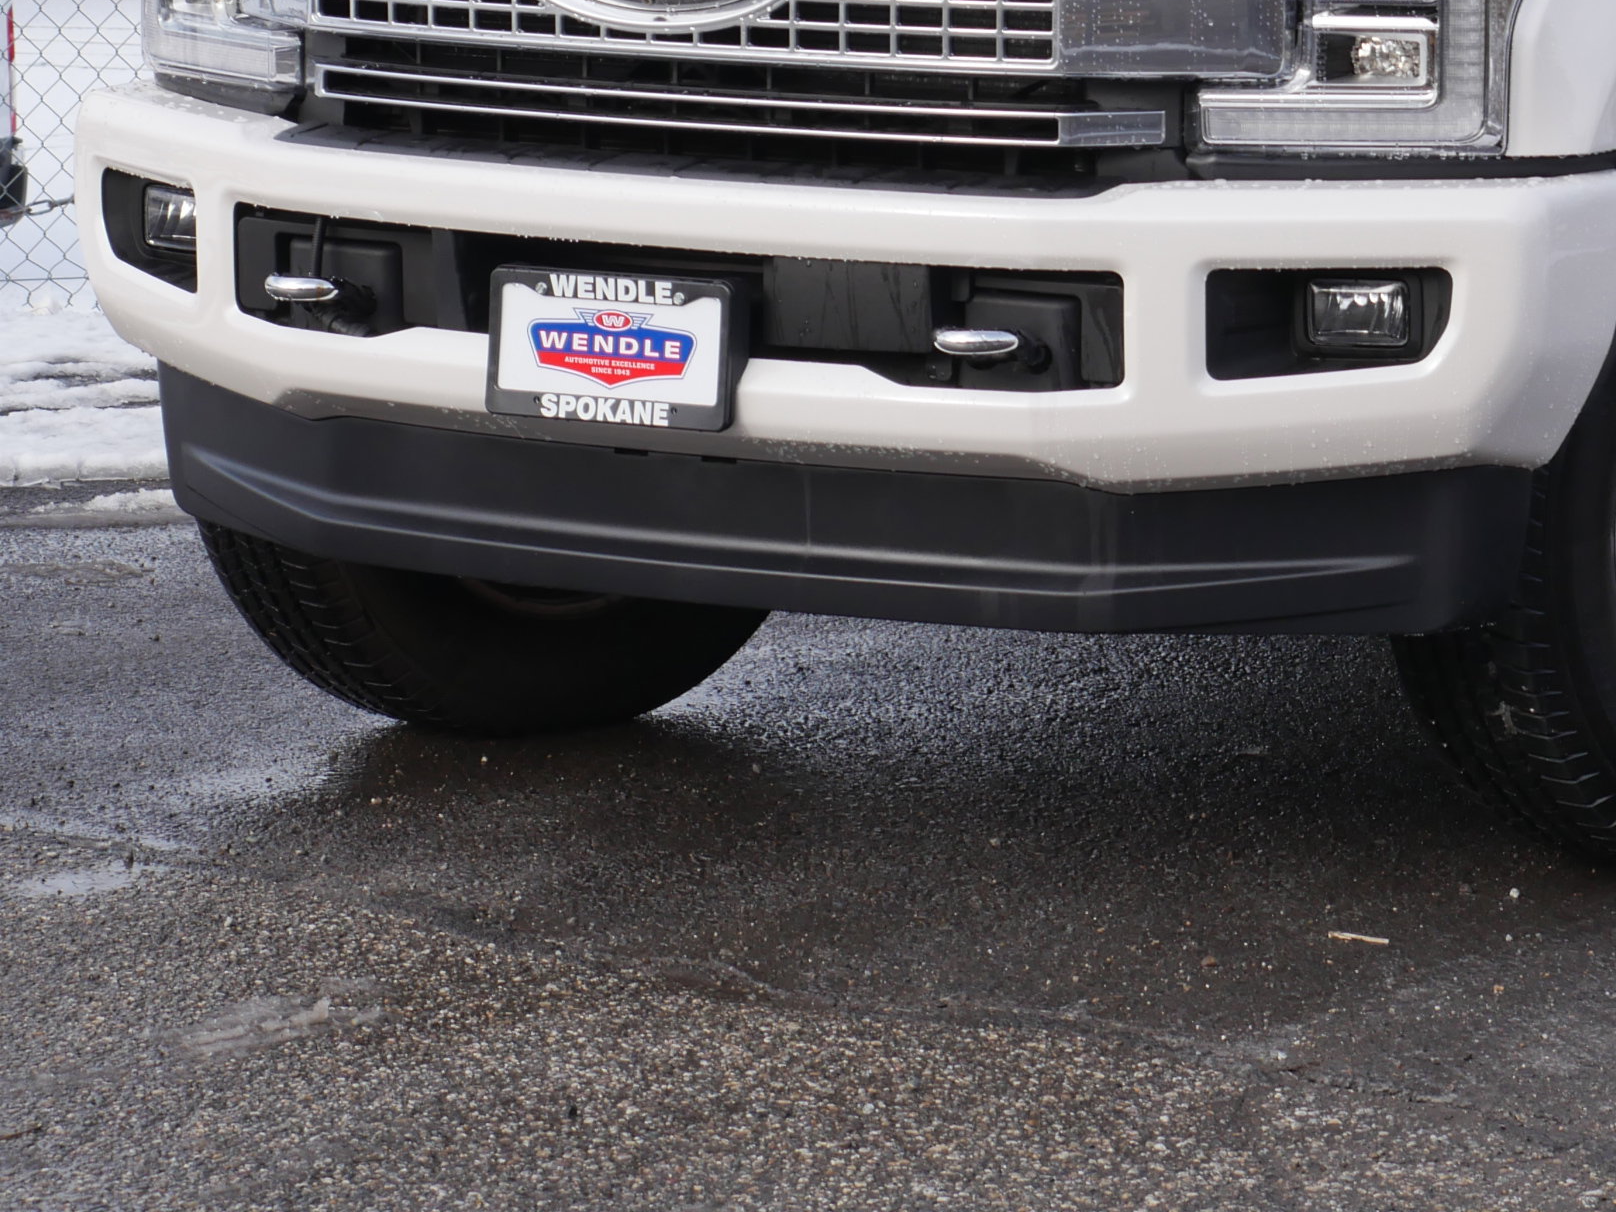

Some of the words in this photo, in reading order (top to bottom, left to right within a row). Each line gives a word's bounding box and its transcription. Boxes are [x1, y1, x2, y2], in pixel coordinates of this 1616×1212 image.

[549, 273, 673, 305] WENDLE
[539, 330, 681, 359] WENDLE
[564, 355, 610, 367] AUTOMOTIVE
[611, 359, 655, 370] EXCELLENCE
[591, 366, 612, 375] SINCE
[540, 393, 670, 427] SPOKANE
